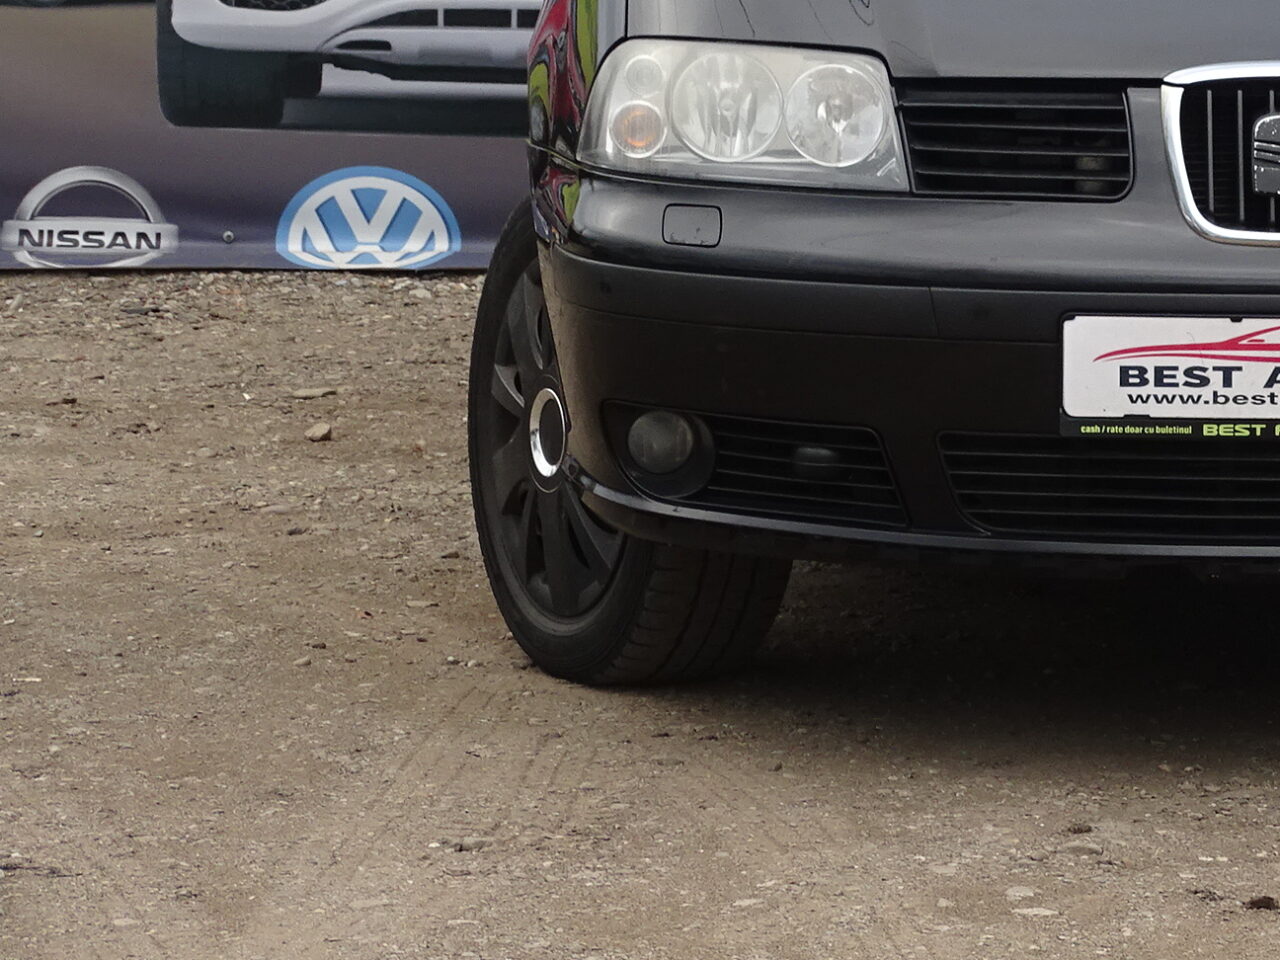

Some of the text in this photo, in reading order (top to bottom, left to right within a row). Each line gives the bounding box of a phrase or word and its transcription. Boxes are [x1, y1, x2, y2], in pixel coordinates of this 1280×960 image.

[18, 229, 161, 250] NISSAN
[1119, 365, 1243, 388] BEST
[1081, 425, 1100, 434] cash
[1124, 425, 1144, 434] doar
[1155, 425, 1193, 435] buletinul
[1203, 424, 1266, 436] BEST
